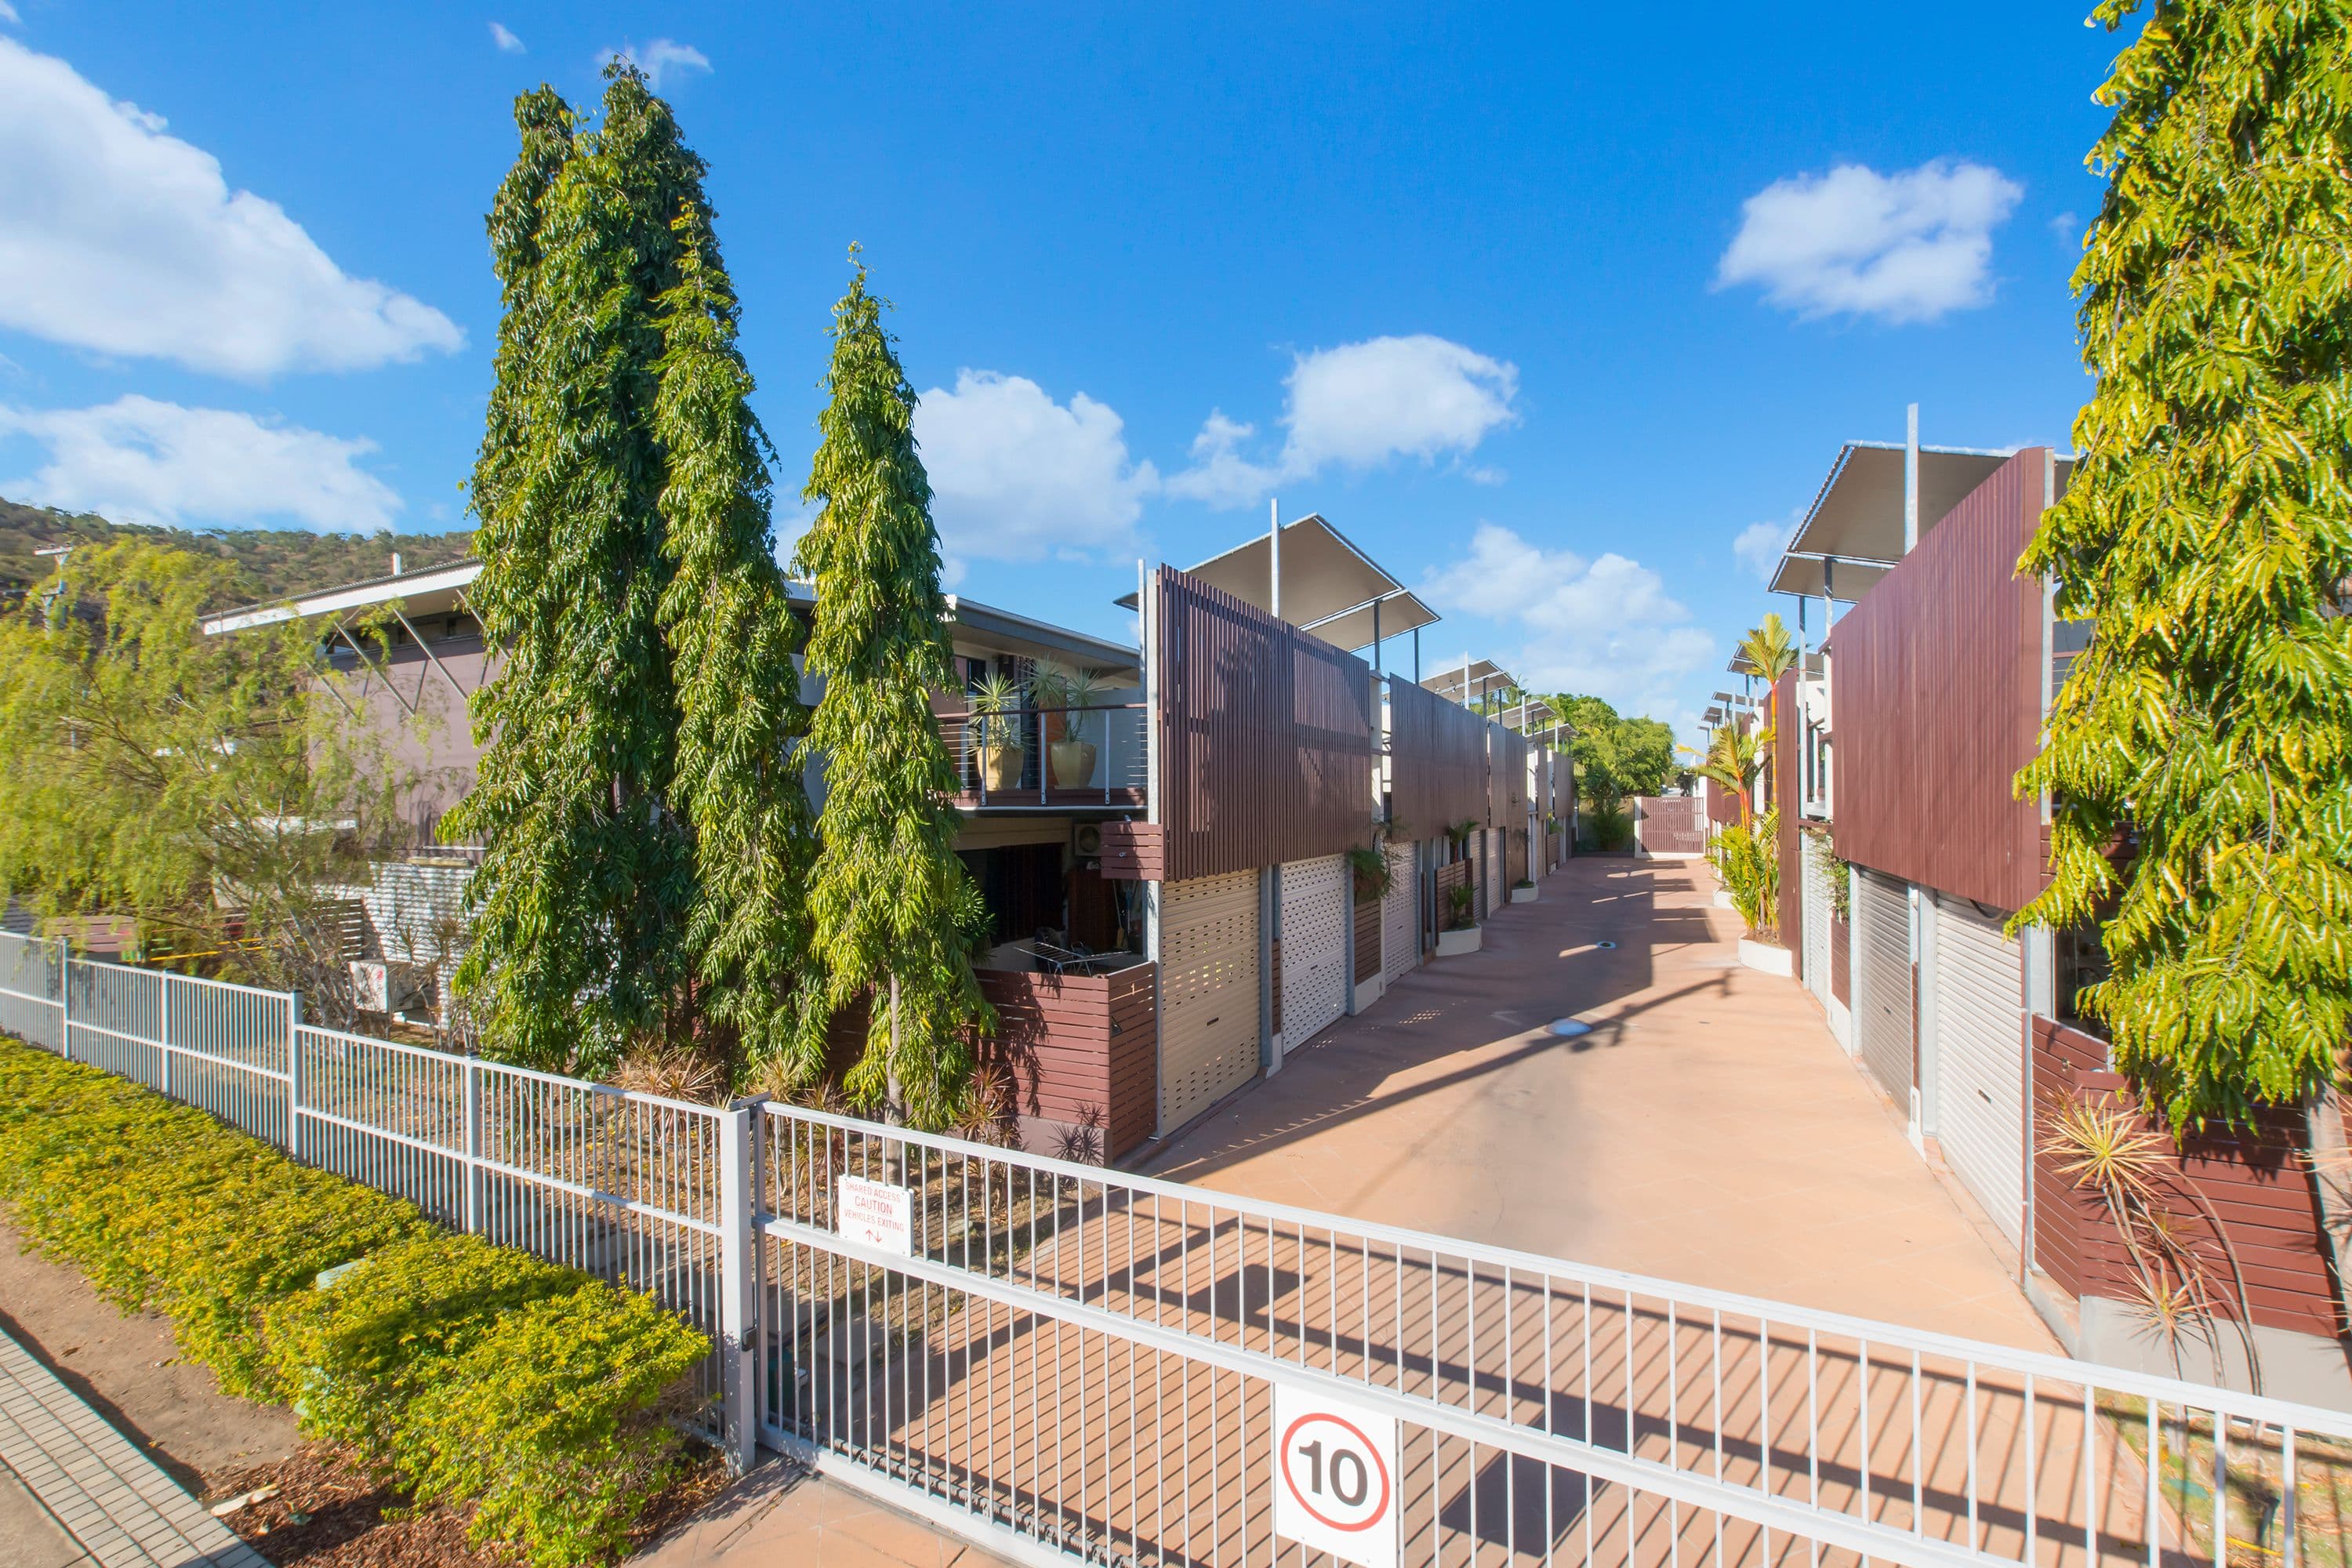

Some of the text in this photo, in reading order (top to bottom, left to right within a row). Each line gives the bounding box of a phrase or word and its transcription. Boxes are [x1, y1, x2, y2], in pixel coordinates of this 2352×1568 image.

[845, 1181, 901, 1203] SHARED ACCESS
[855, 1196, 892, 1215] CAUTION
[844, 1209, 904, 1232] VEHICLES EXITING
[1298, 1439, 1368, 1507] 10
